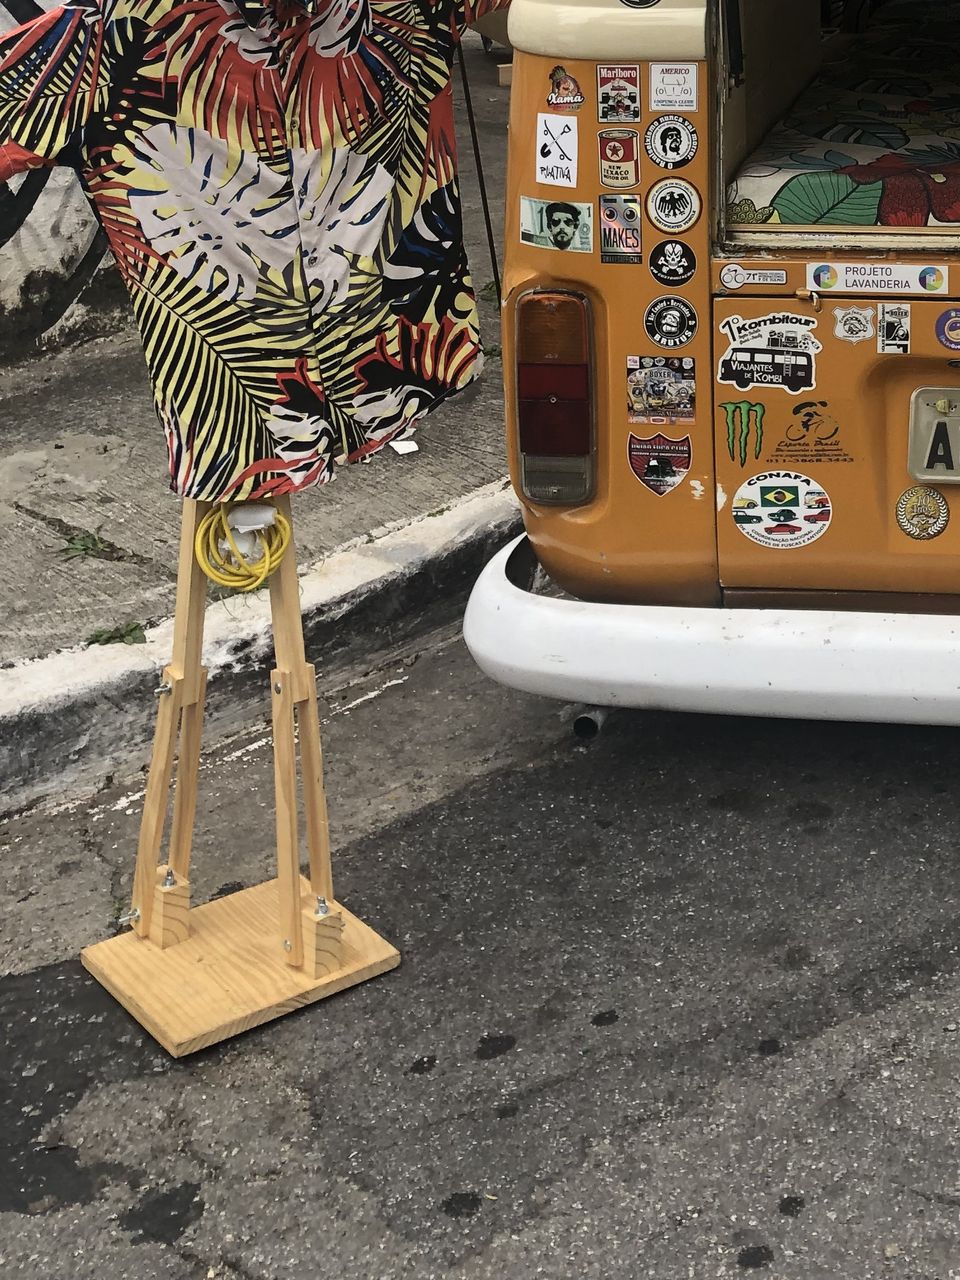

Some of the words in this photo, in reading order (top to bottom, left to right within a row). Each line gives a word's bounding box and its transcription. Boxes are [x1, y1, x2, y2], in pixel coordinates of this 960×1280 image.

[600, 68, 637, 78] Marlboro
[660, 67, 690, 75] AMERICO
[659, 115, 683, 123] nunca
[602, 228, 639, 249] MAKES
[845, 267, 893, 277] PROJETO
[845, 279, 911, 289] LAVANDERIA
[736, 314, 816, 335] Kombitour
[654, 329, 692, 346] BRUTUS
[731, 360, 774, 372] VIAJANTES
[753, 372, 783, 382] KOMBI
[747, 472, 812, 486] CONAFA
[751, 529, 791, 543] COORDENAÇÃO
[792, 529, 815, 542] NACIONAL
